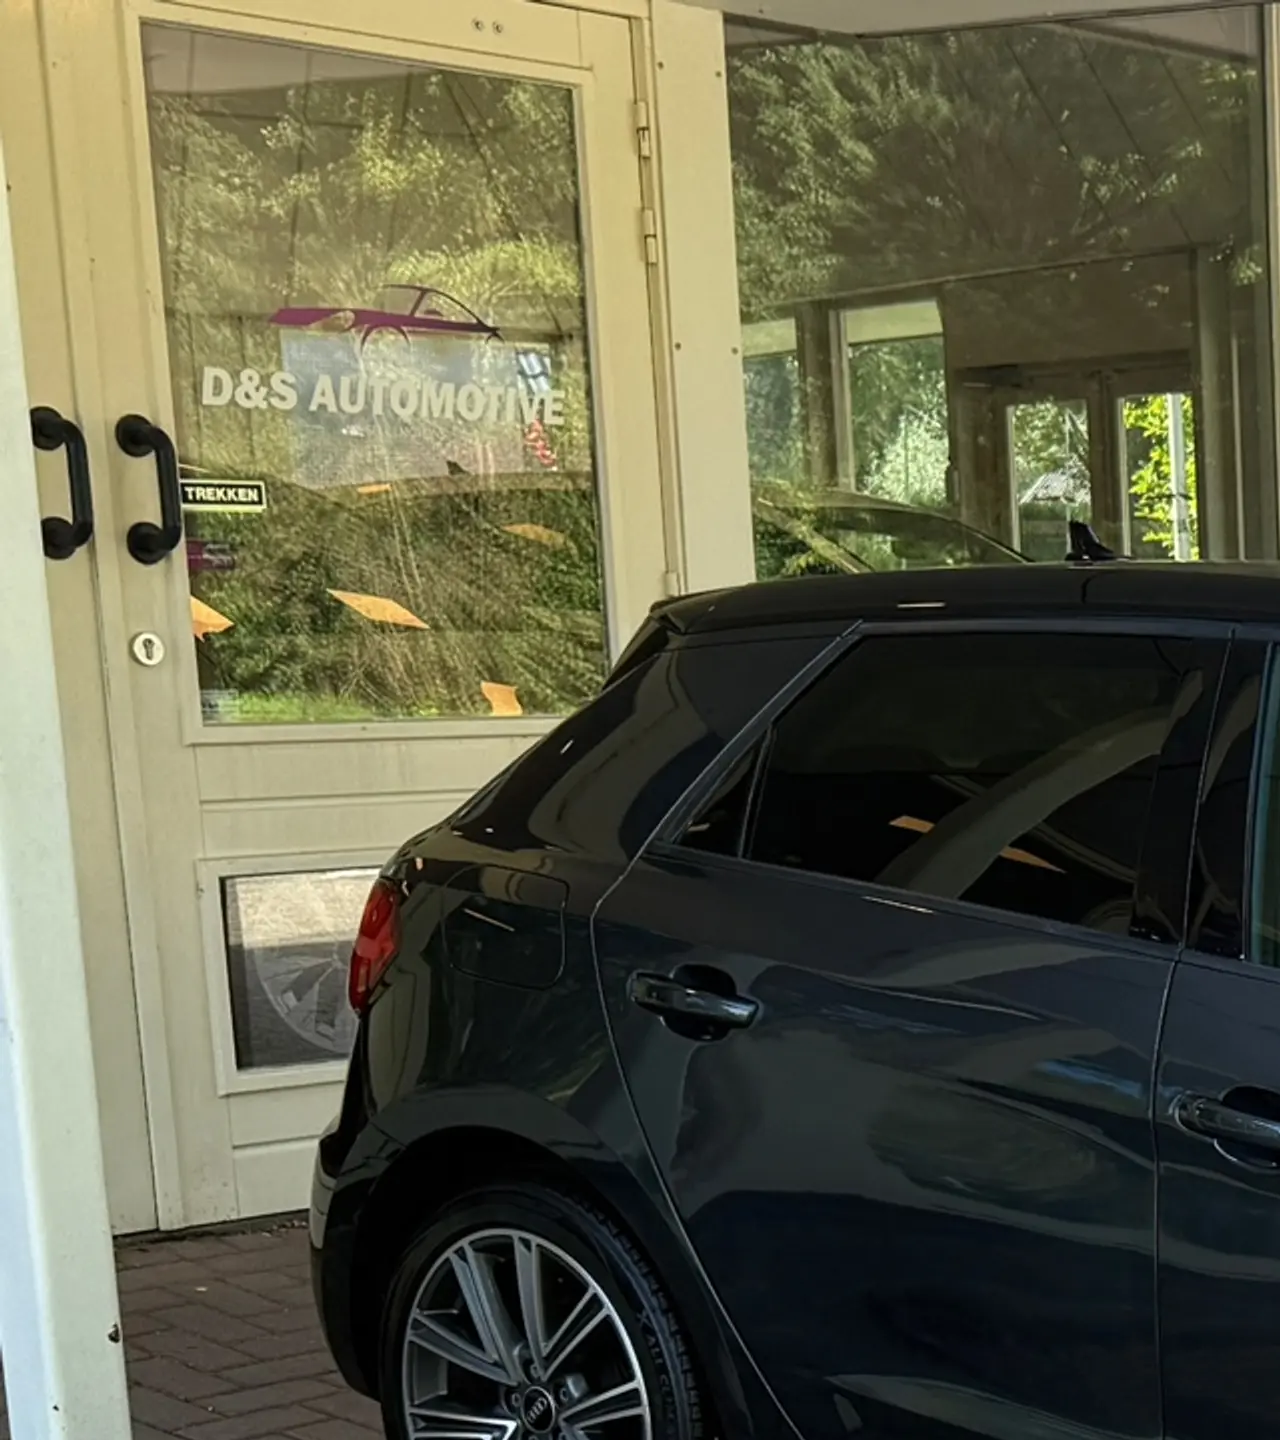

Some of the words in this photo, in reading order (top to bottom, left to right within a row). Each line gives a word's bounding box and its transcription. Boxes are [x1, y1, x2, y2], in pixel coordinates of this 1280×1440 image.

[202, 366, 298, 410] D&S
[309, 373, 565, 426] AUTOMOTIVE
[184, 486, 259, 502] TREKKEN
